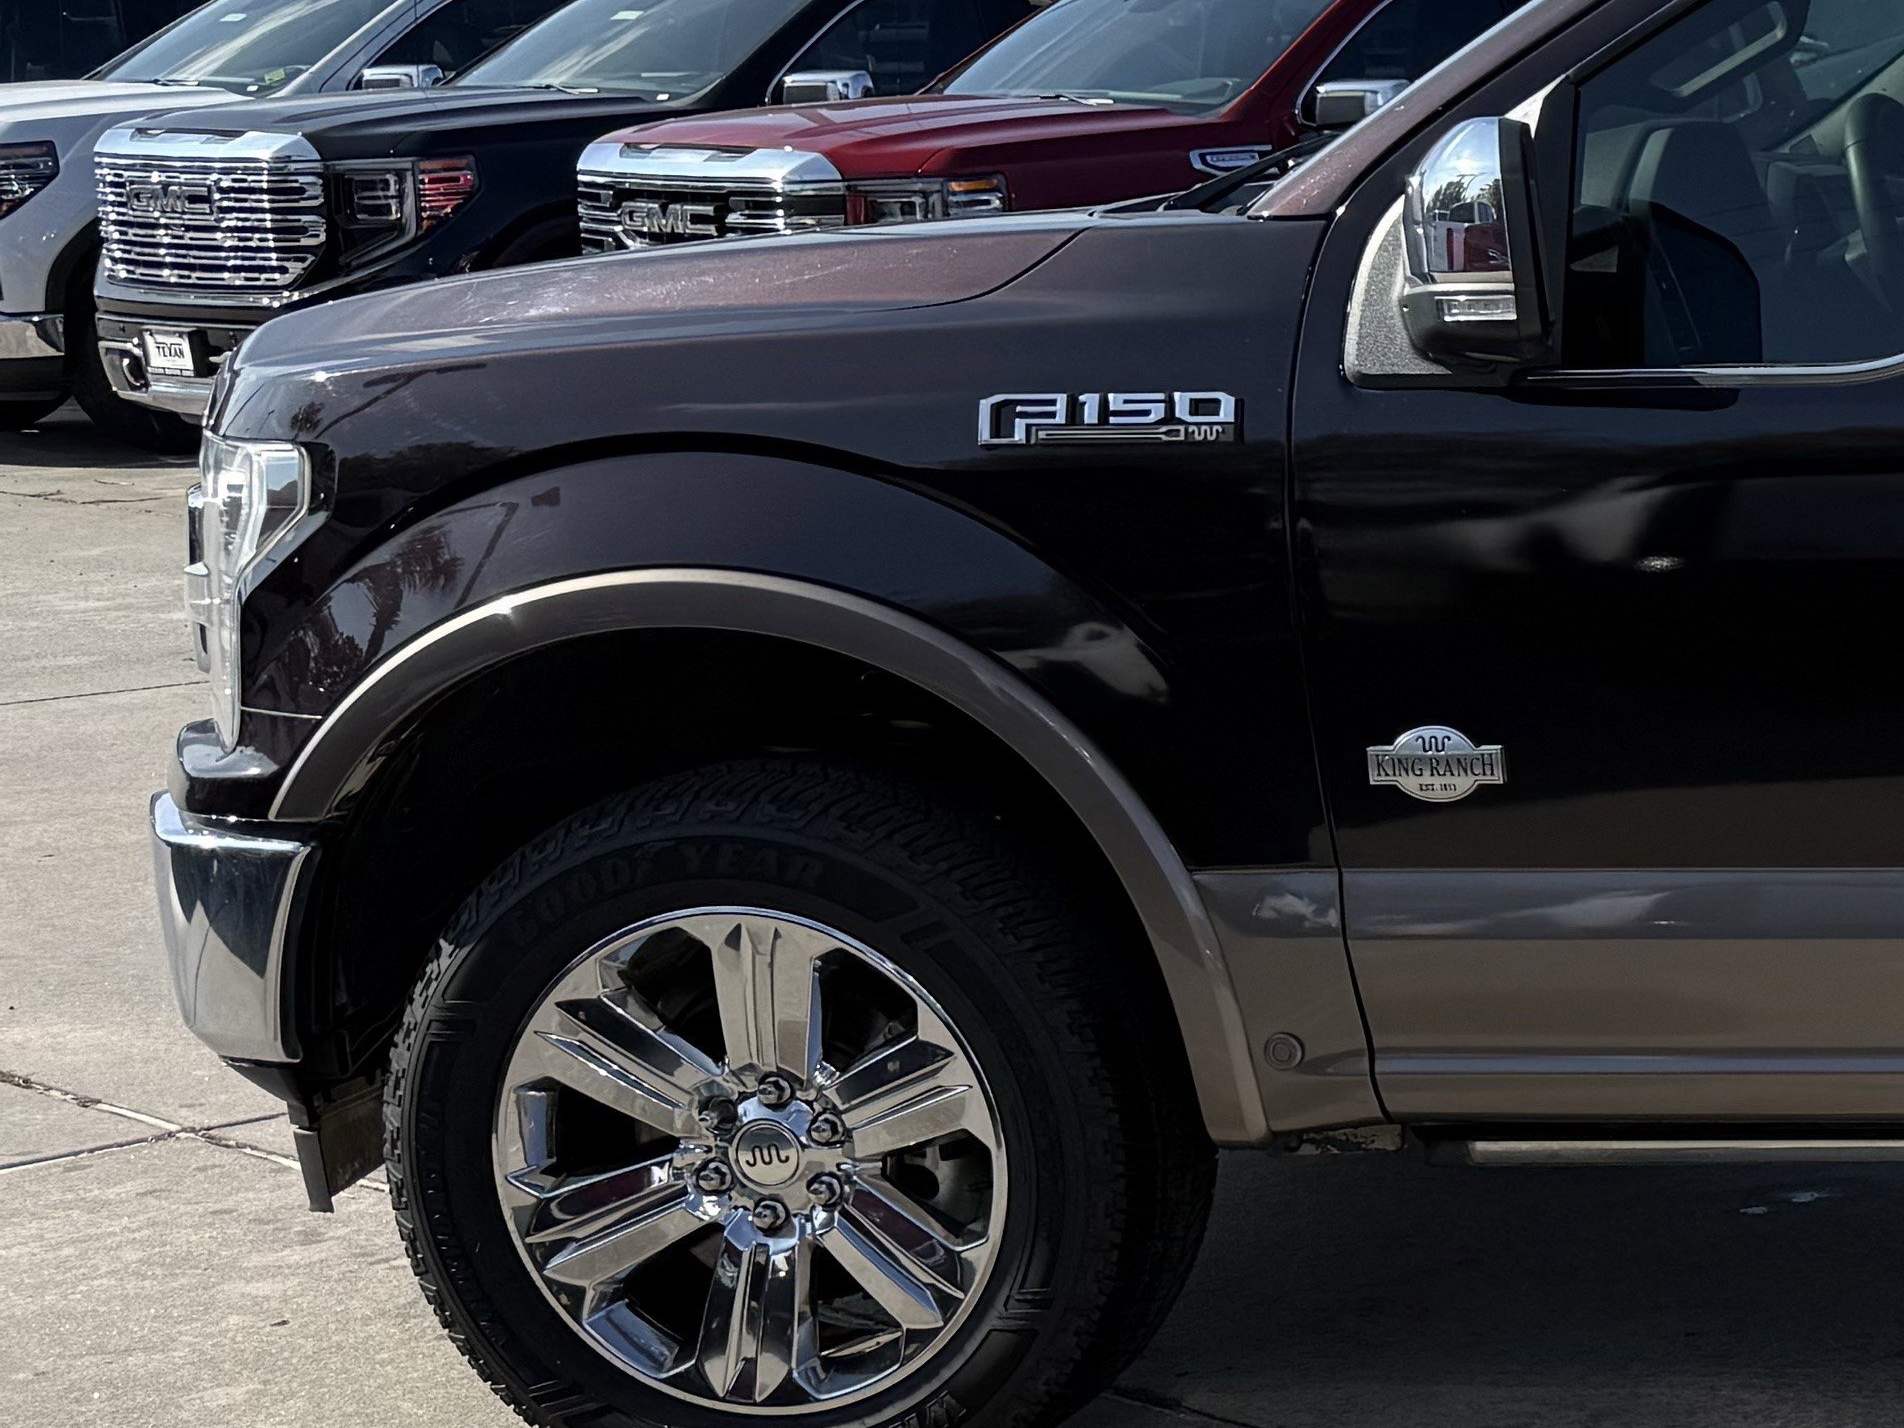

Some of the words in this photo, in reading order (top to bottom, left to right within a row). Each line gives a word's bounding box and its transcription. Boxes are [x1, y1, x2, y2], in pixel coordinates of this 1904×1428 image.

[129, 185, 211, 214] GMC
[621, 201, 718, 236] GMC
[1376, 753, 1424, 778] KING
[1429, 752, 1495, 778] RANCH
